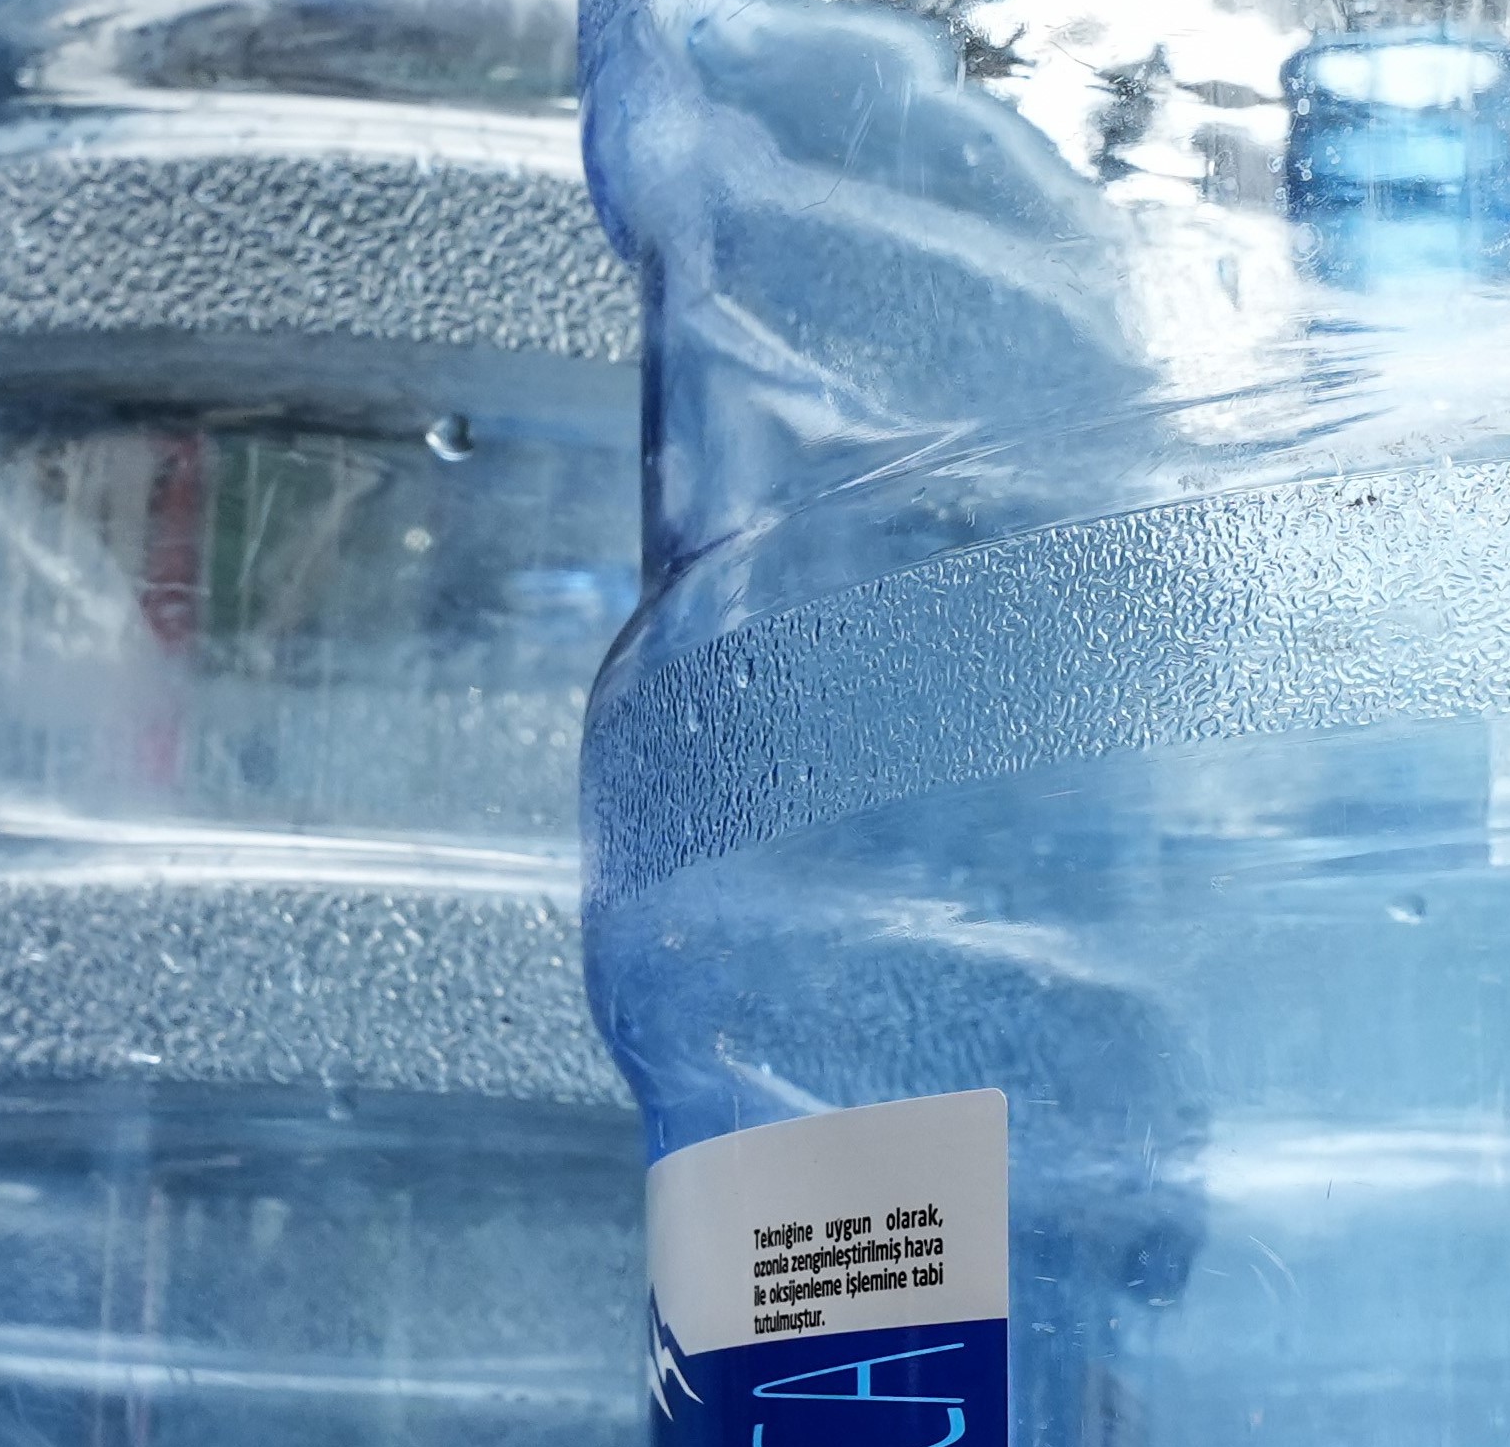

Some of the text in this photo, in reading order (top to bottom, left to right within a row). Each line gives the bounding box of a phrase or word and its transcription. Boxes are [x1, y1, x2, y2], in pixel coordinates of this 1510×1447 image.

[753, 1203, 944, 1250] Tekniğine uygun olarak,
[753, 1235, 944, 1278] ozonla zenginleştirilmiş hava
[753, 1262, 944, 1307] ile oksijenleme işlemine tabi
[754, 1308, 826, 1334] tutulmuştur.
